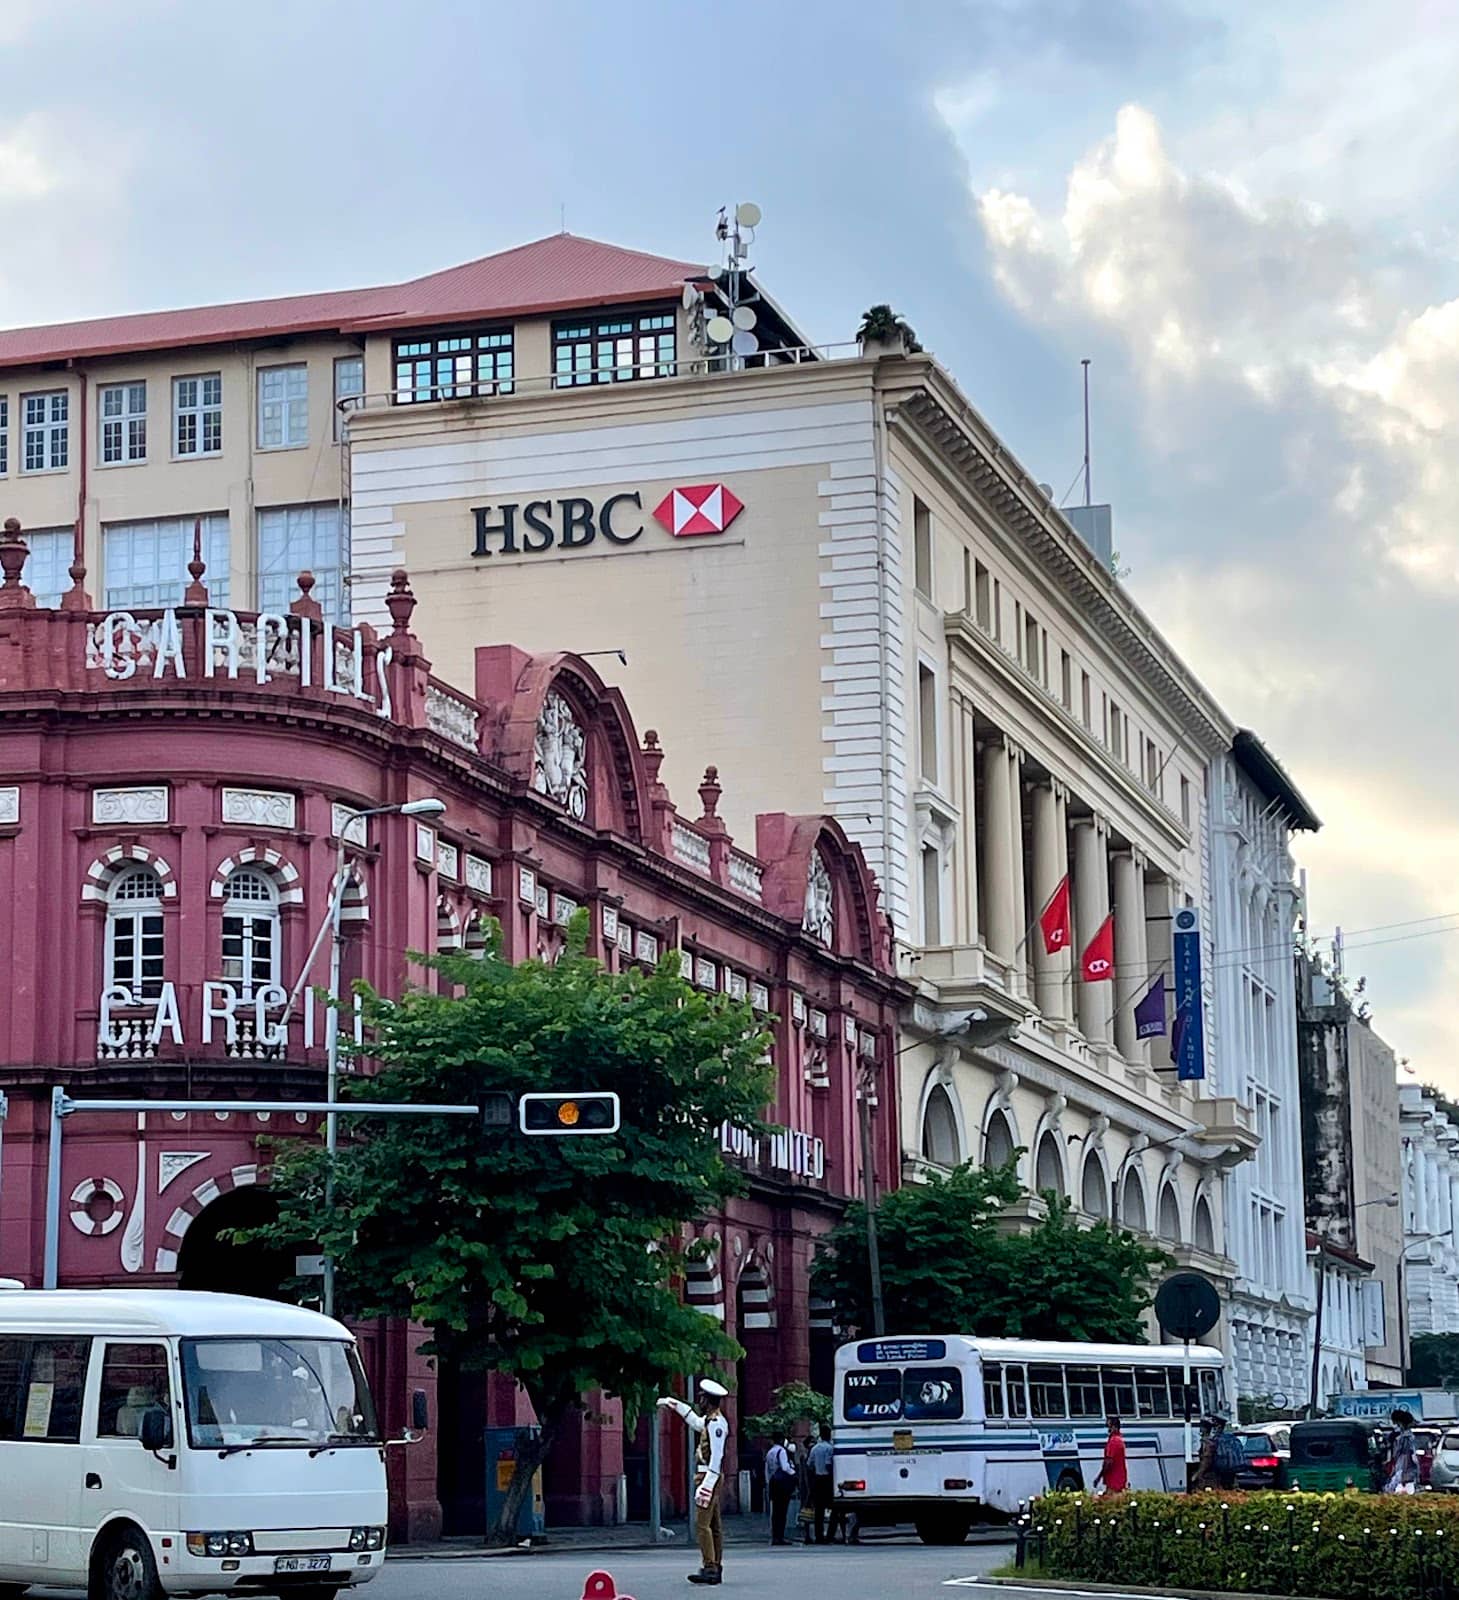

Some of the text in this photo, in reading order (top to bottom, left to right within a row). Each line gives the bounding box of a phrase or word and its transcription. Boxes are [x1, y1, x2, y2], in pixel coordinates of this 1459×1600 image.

[470, 491, 644, 557] HSBC
[848, 1376, 878, 1387] WIN
[863, 1401, 900, 1414] LION
